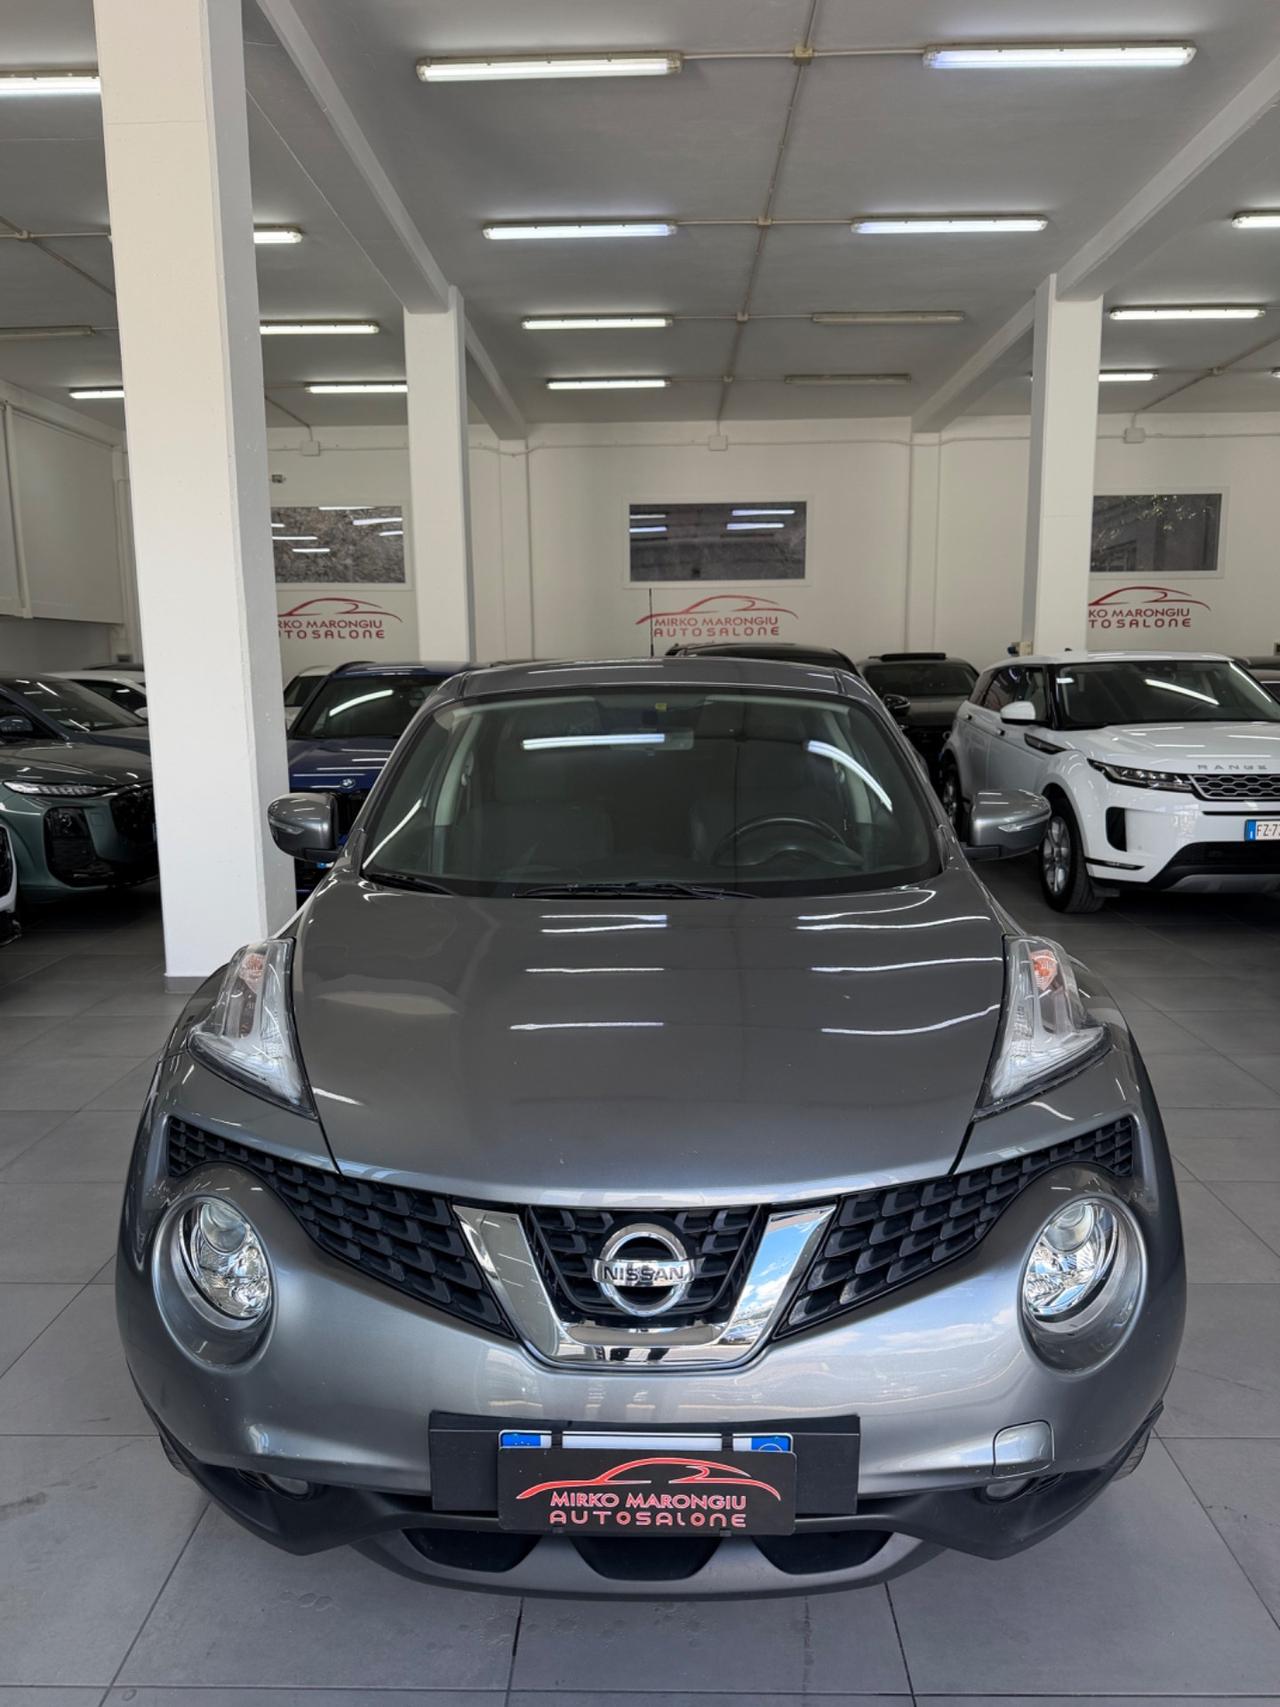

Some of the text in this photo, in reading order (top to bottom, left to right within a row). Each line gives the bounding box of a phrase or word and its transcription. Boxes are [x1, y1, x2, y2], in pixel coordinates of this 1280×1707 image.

[1111, 608, 1190, 618] MARONGIU
[277, 619, 383, 629] RKO MARONGIU
[654, 616, 779, 627] MIRKO MARONGIU
[1088, 618, 1192, 629] TOSALONE
[278, 629, 385, 640] TOSALONE
[653, 626, 780, 638] AUTOSALONE
[603, 1264, 684, 1281] NISSAN
[550, 1491, 747, 1511] MIRKO MARONGIU
[549, 1510, 746, 1528] AUTOSALONE
